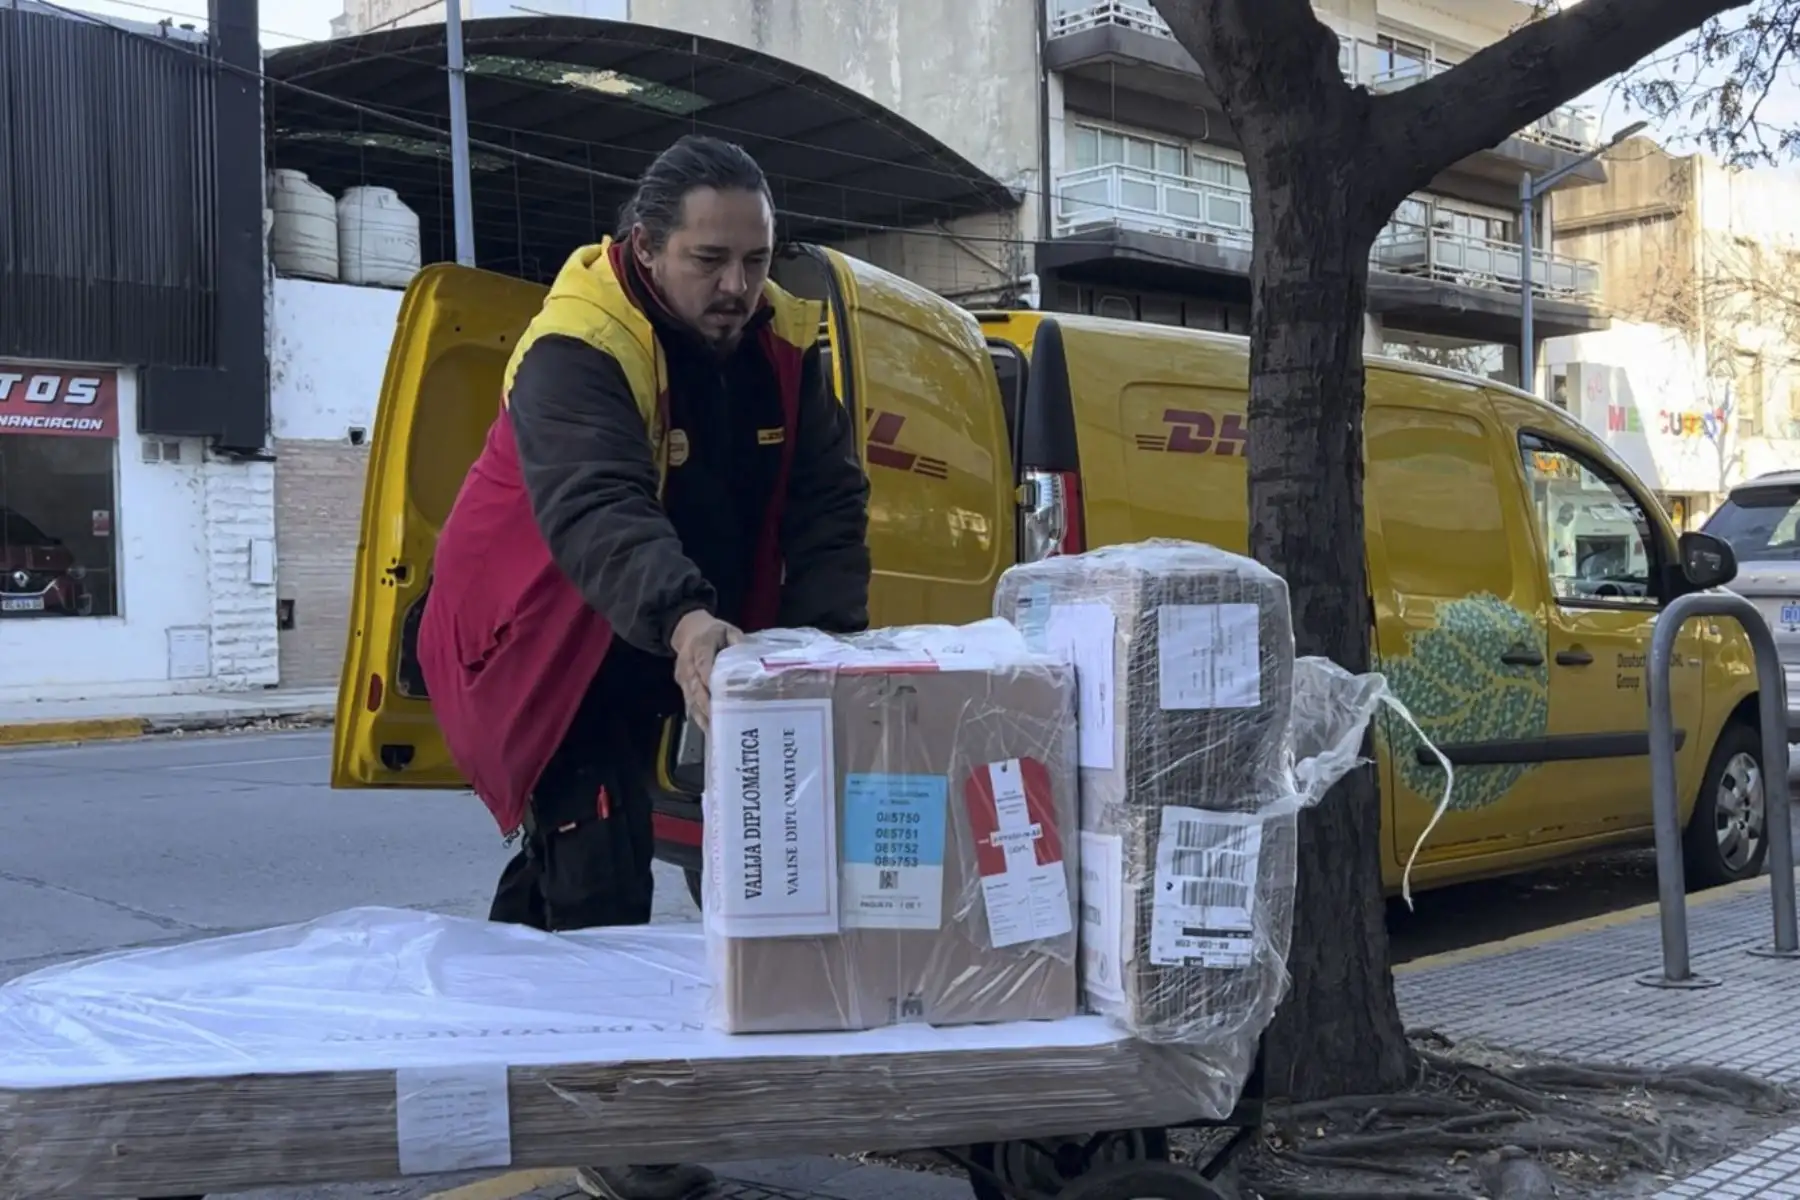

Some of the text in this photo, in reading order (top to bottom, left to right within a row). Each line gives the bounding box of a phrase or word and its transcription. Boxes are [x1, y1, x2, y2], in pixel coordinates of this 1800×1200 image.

[1616, 673, 1639, 692] Group
[736, 728, 763, 900] VALIJA DIPLOMÁTICA
[783, 728, 799, 896] VALISE DIPLOMATIQUE
